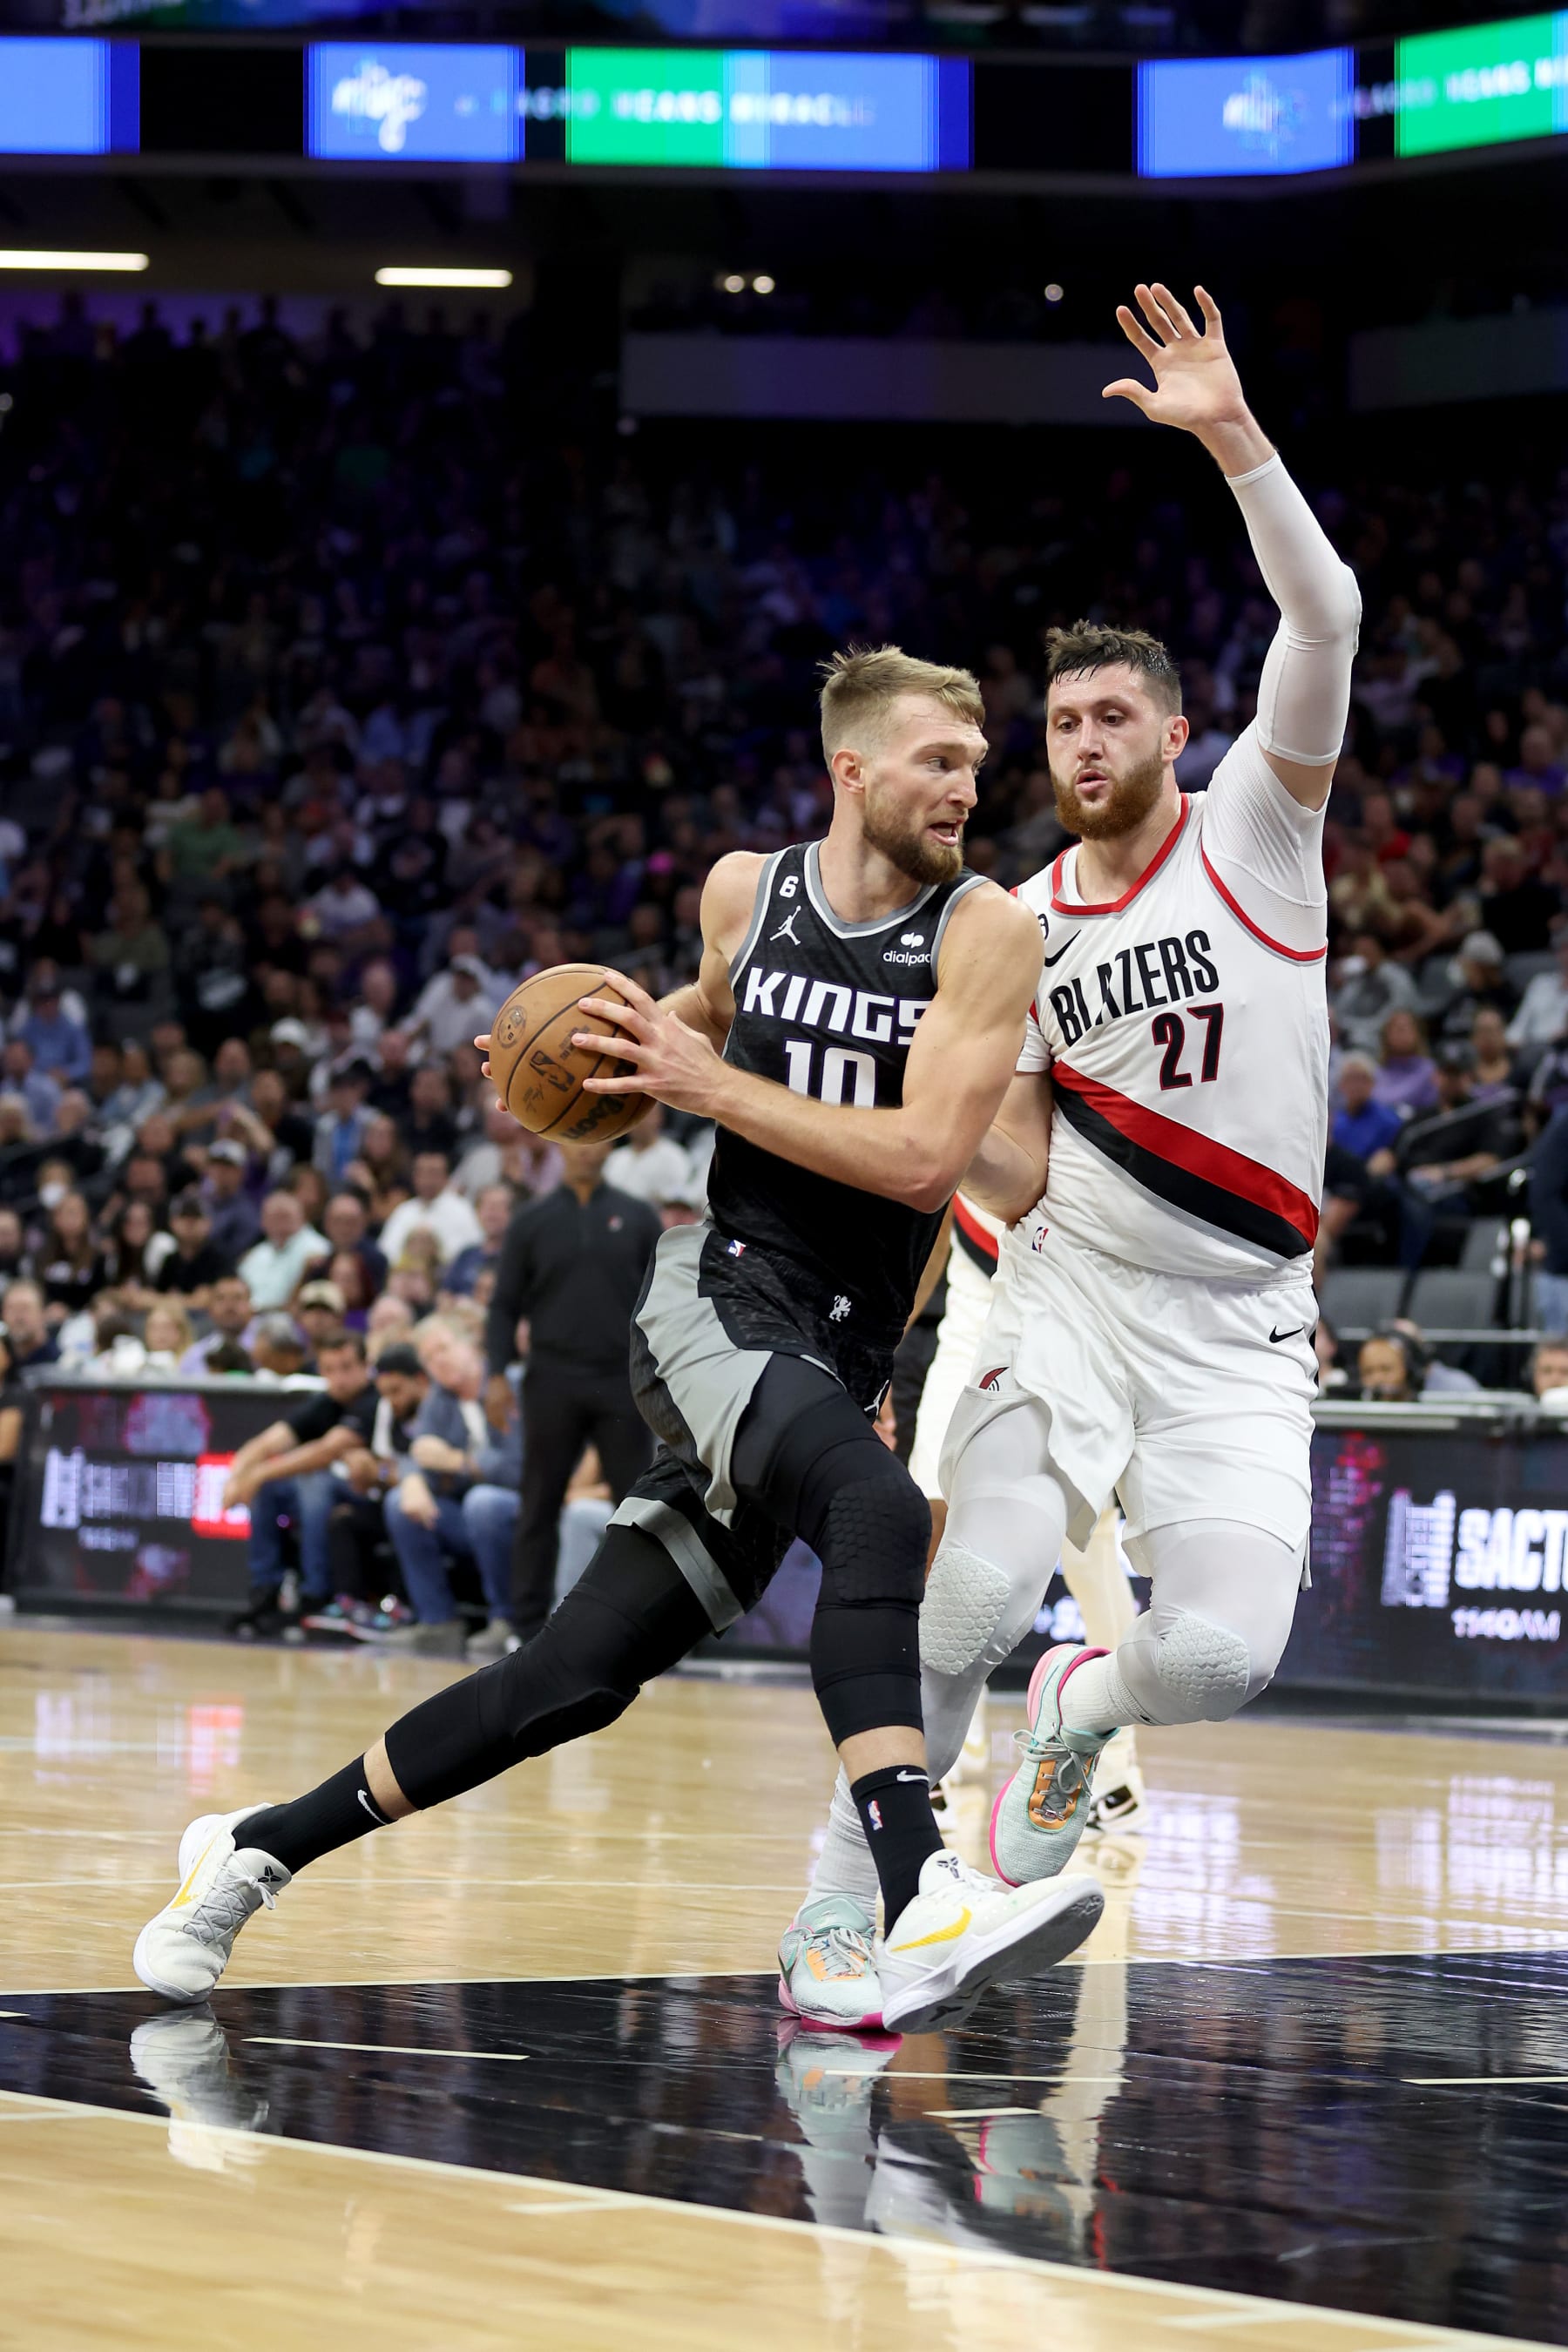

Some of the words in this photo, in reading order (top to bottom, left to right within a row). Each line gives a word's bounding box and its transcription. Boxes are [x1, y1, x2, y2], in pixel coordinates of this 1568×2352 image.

[779, 875, 800, 899] 6
[741, 966, 932, 1046] KINGS
[1048, 928, 1220, 1048] BLAZERS
[783, 1037, 876, 1109] 10
[1151, 1002, 1225, 1092] 27
[1454, 1507, 1568, 1592] SACT
